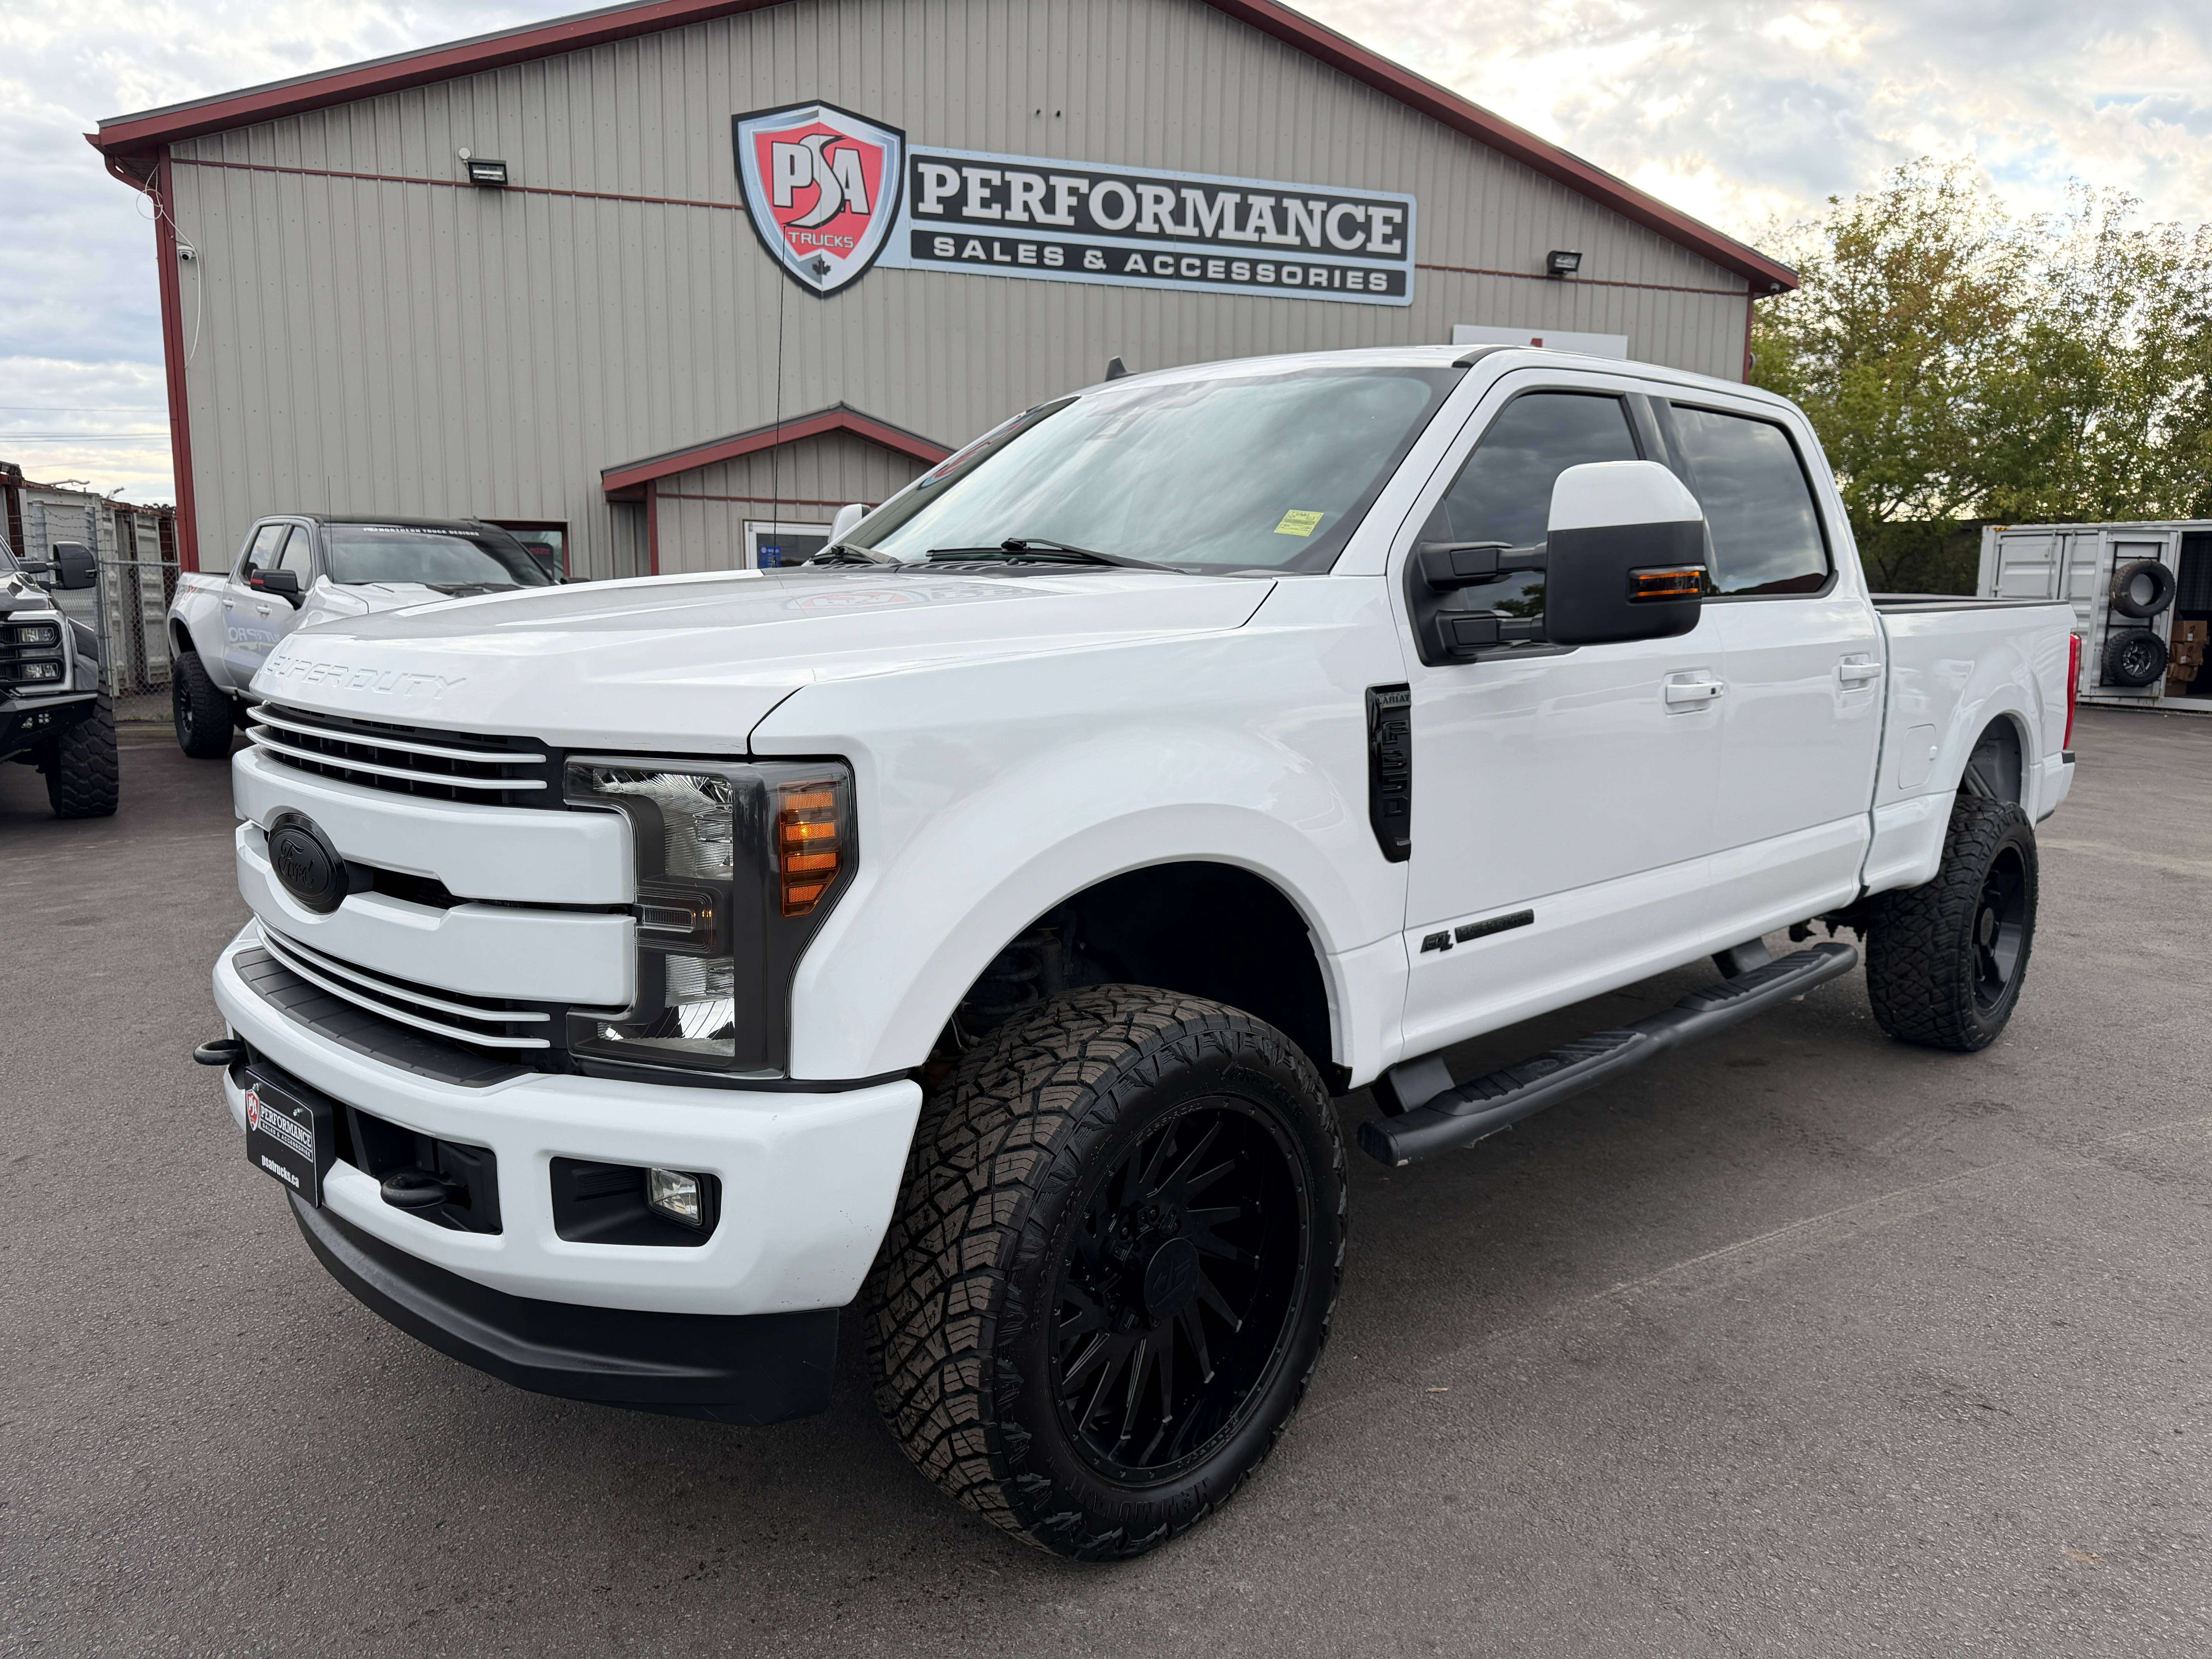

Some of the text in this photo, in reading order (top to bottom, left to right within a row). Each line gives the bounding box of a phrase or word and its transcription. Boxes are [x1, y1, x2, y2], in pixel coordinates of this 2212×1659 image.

[772, 134, 871, 230] PSA
[917, 162, 1402, 254] PERFORMANCE
[787, 232, 854, 248] TRUCKS
[933, 236, 1388, 292] SALES & ACCESSORIES
[264, 655, 467, 699] SUPER DUTY
[1377, 694, 1410, 705] LARIAT
[278, 838, 314, 889] Ford
[261, 1105, 312, 1148] PERFORMANCE
[262, 1123, 276, 1135] SALES
[281, 1134, 311, 1157] ACCESSORIES
[261, 1155, 299, 1188] psatrucks.ca
